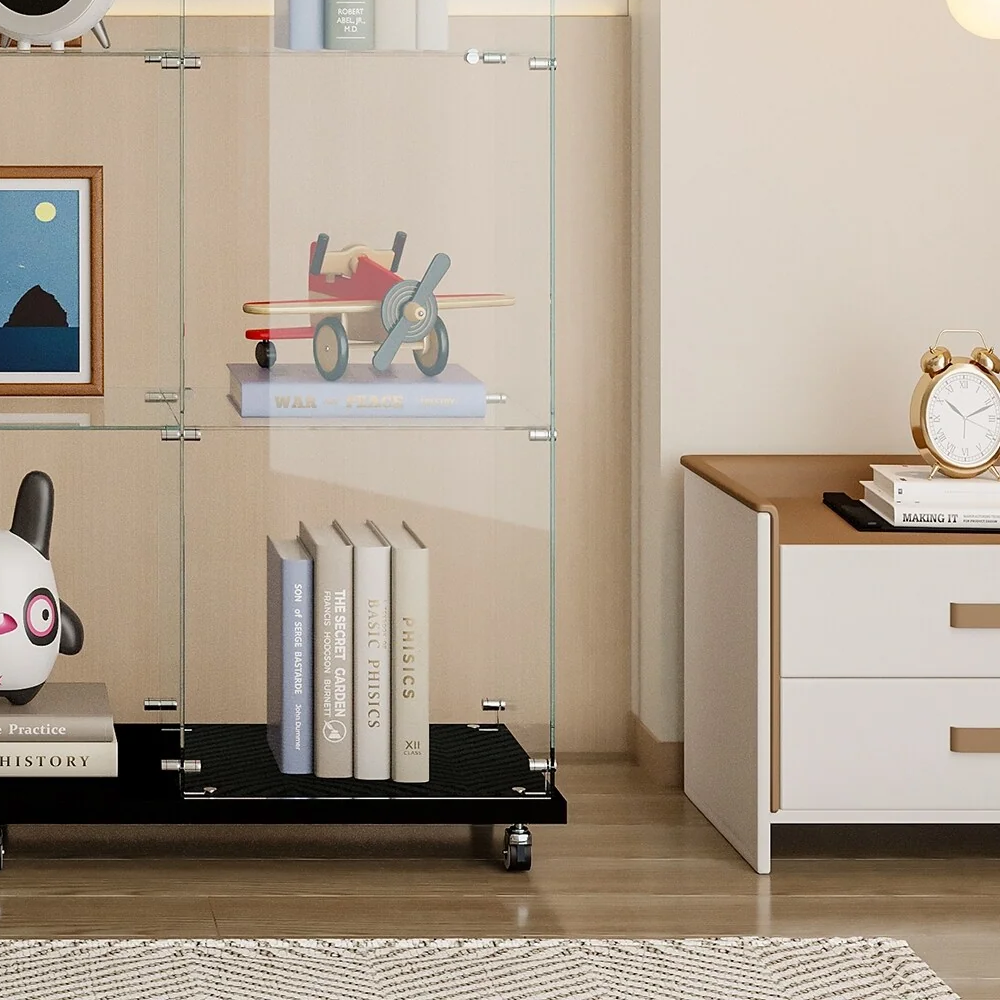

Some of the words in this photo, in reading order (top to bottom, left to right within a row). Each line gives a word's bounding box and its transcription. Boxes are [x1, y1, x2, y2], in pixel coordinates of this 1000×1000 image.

[274, 396, 318, 409] WAR
[902, 513, 945, 523] MAKING
[948, 514, 959, 523] IT
[294, 583, 302, 602] SON
[334, 589, 346, 613] THE
[294, 608, 302, 619] of
[324, 591, 332, 626] FRANCIS
[294, 621, 302, 648] SERGE
[334, 615, 346, 660] SECRET
[368, 599, 380, 649] BASIC
[324, 632, 332, 675] HODGSON
[402, 618, 415, 699] PHISICS
[294, 651, 302, 694] BASTARDE
[324, 678, 332, 717] BURNETT
[334, 668, 346, 717] GARDEN
[368, 660, 380, 729] PHISICS
[294, 704, 302, 721] John
[8, 723, 66, 735] Practice
[405, 741, 420, 750] XII
[0, 755, 91, 767] HISTORY
